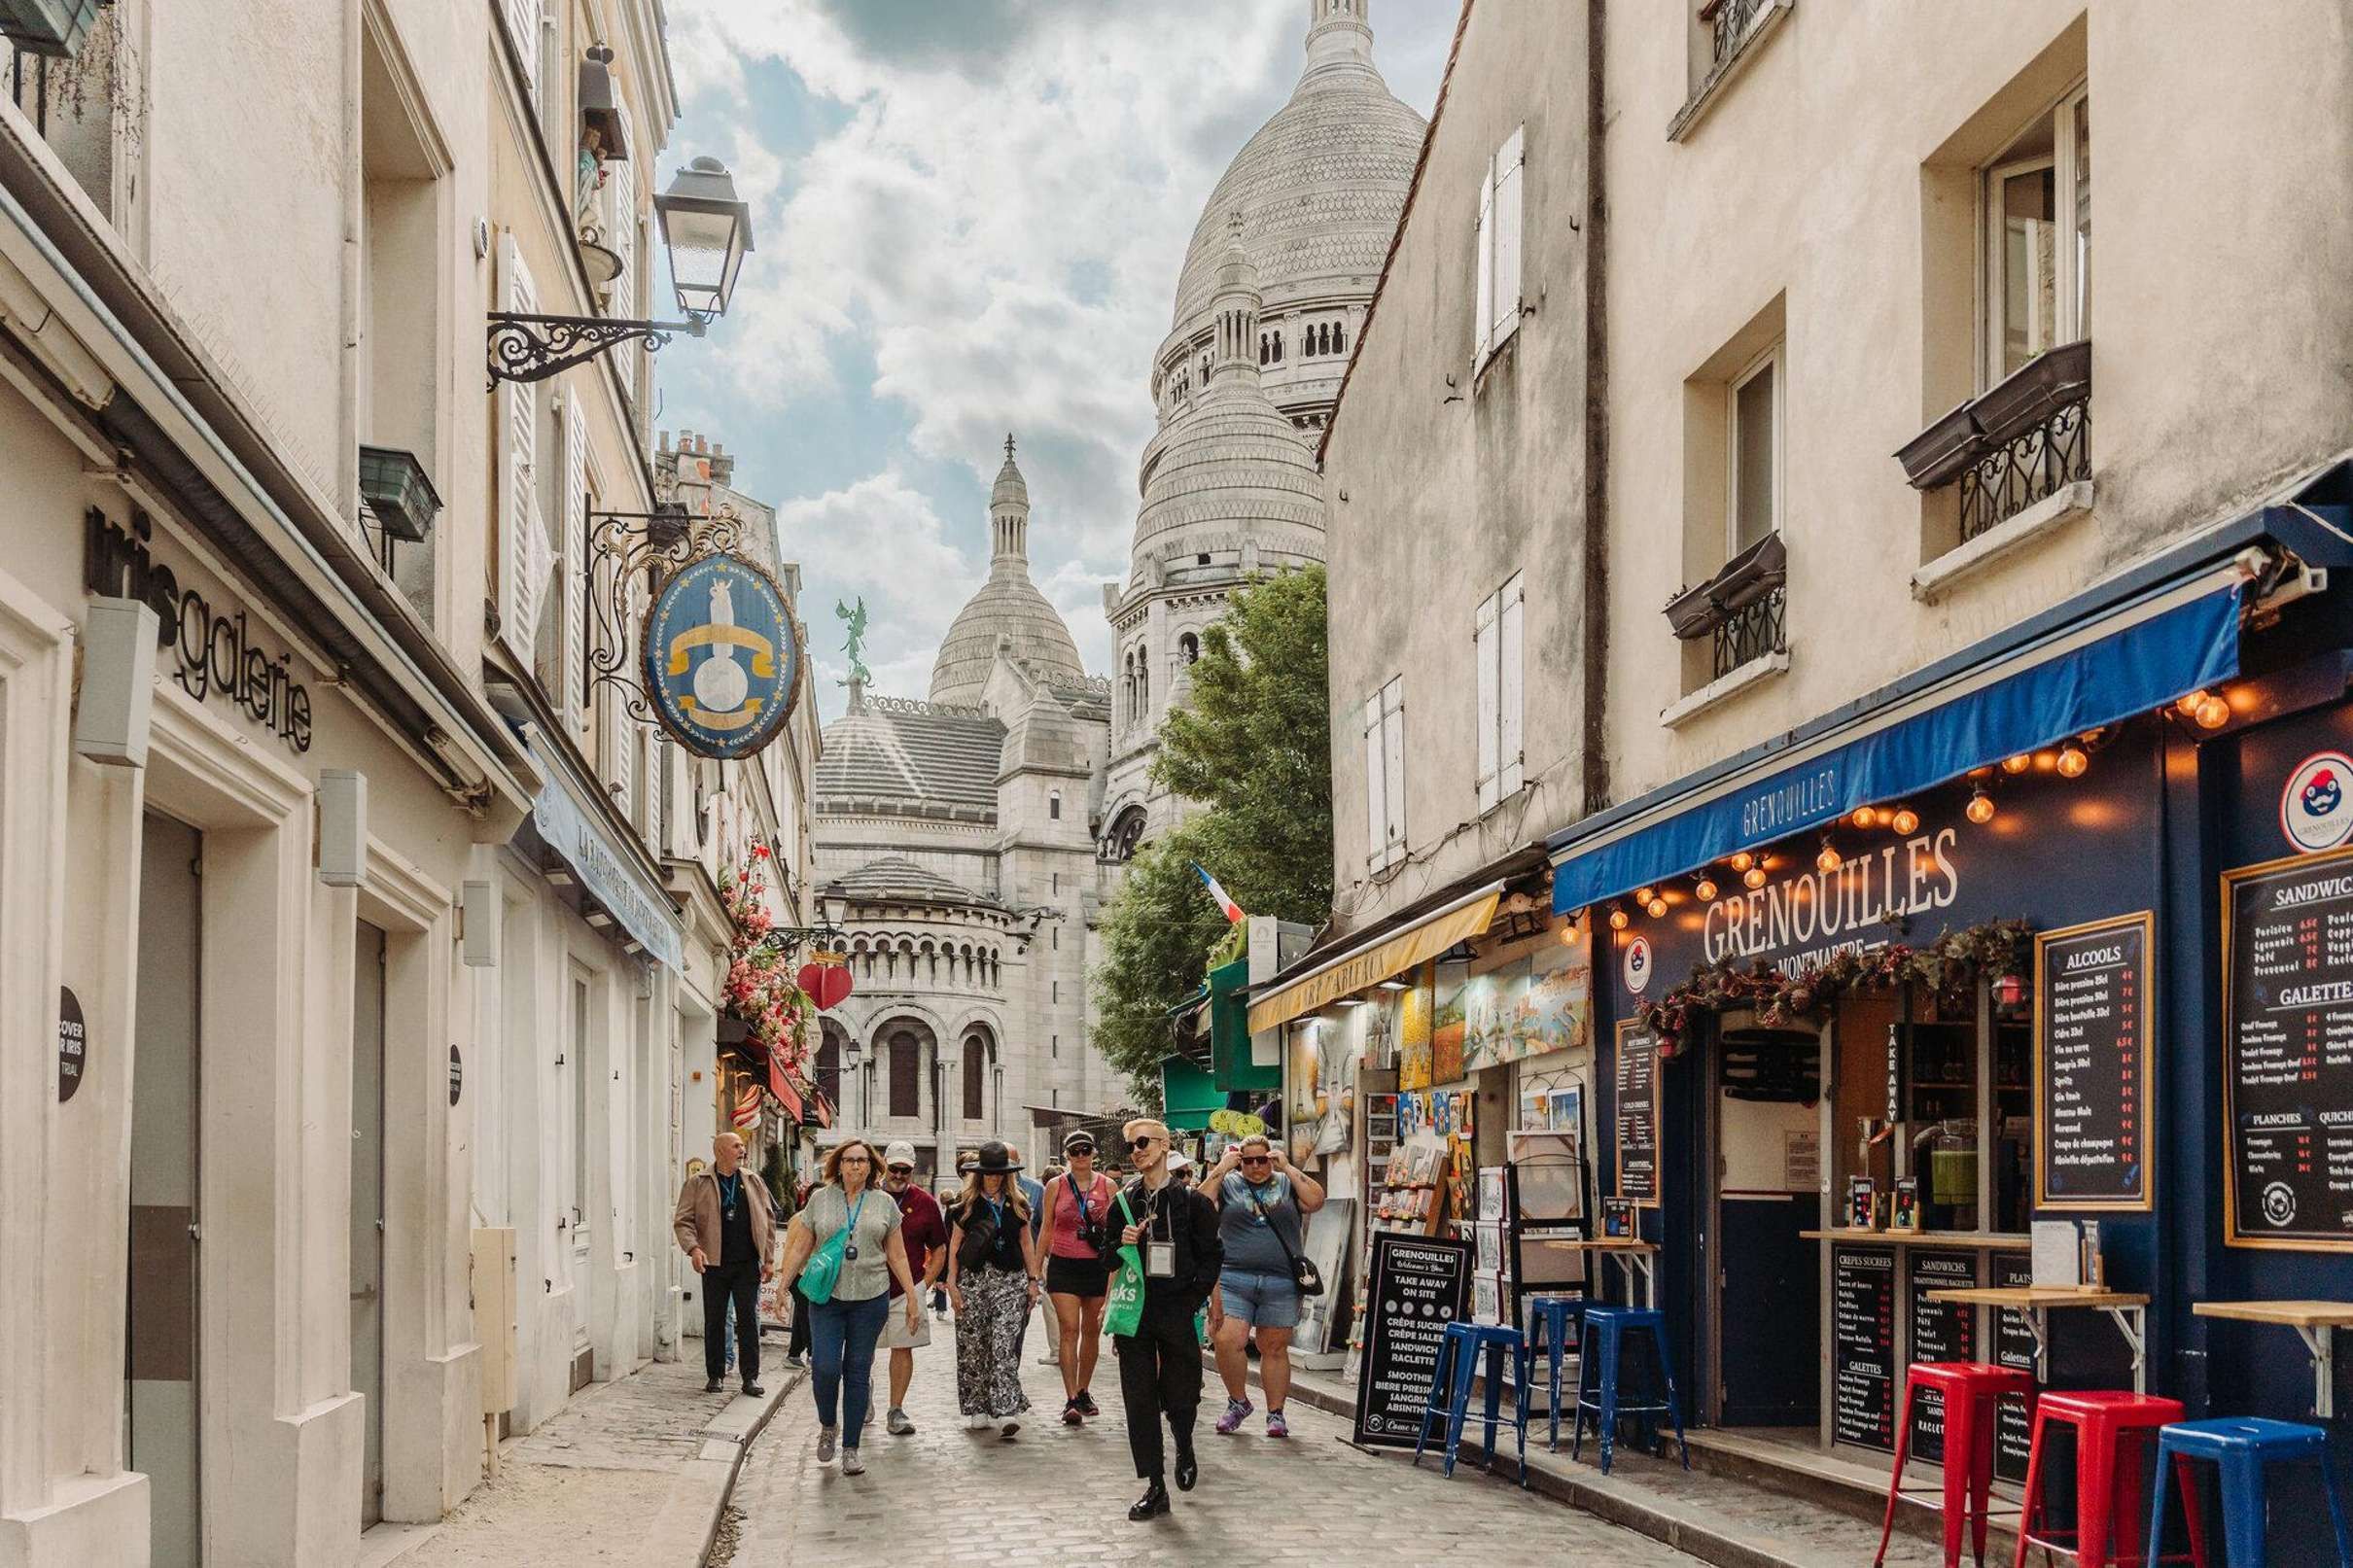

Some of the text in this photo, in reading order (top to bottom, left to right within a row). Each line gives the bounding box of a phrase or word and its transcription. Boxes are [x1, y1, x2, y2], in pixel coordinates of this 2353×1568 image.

[1742, 769, 1835, 838] GRENOUILLES
[1703, 827, 1958, 966] GRENOUILLES
[2066, 946, 2122, 969] ALCOOLS
[66, 1038, 83, 1056] IRIS
[1888, 1024, 1897, 1121] TAKE AWAY
[2253, 1112, 2301, 1126] PLANCHES
[1391, 1248, 1455, 1264] GRENOUILLES
[1394, 1275, 1448, 1289] TAKE AWAY
[1402, 1288, 1436, 1300] ON SITE
[1387, 1317, 1416, 1329] CRÊPE
[1390, 1342, 1438, 1355] SANDWICH
[1391, 1353, 1435, 1366] RACLETTE
[2001, 1350, 2030, 1364] Galettes
[1849, 1360, 1882, 1375] GALETTES
[1387, 1420, 1409, 1432] Come
